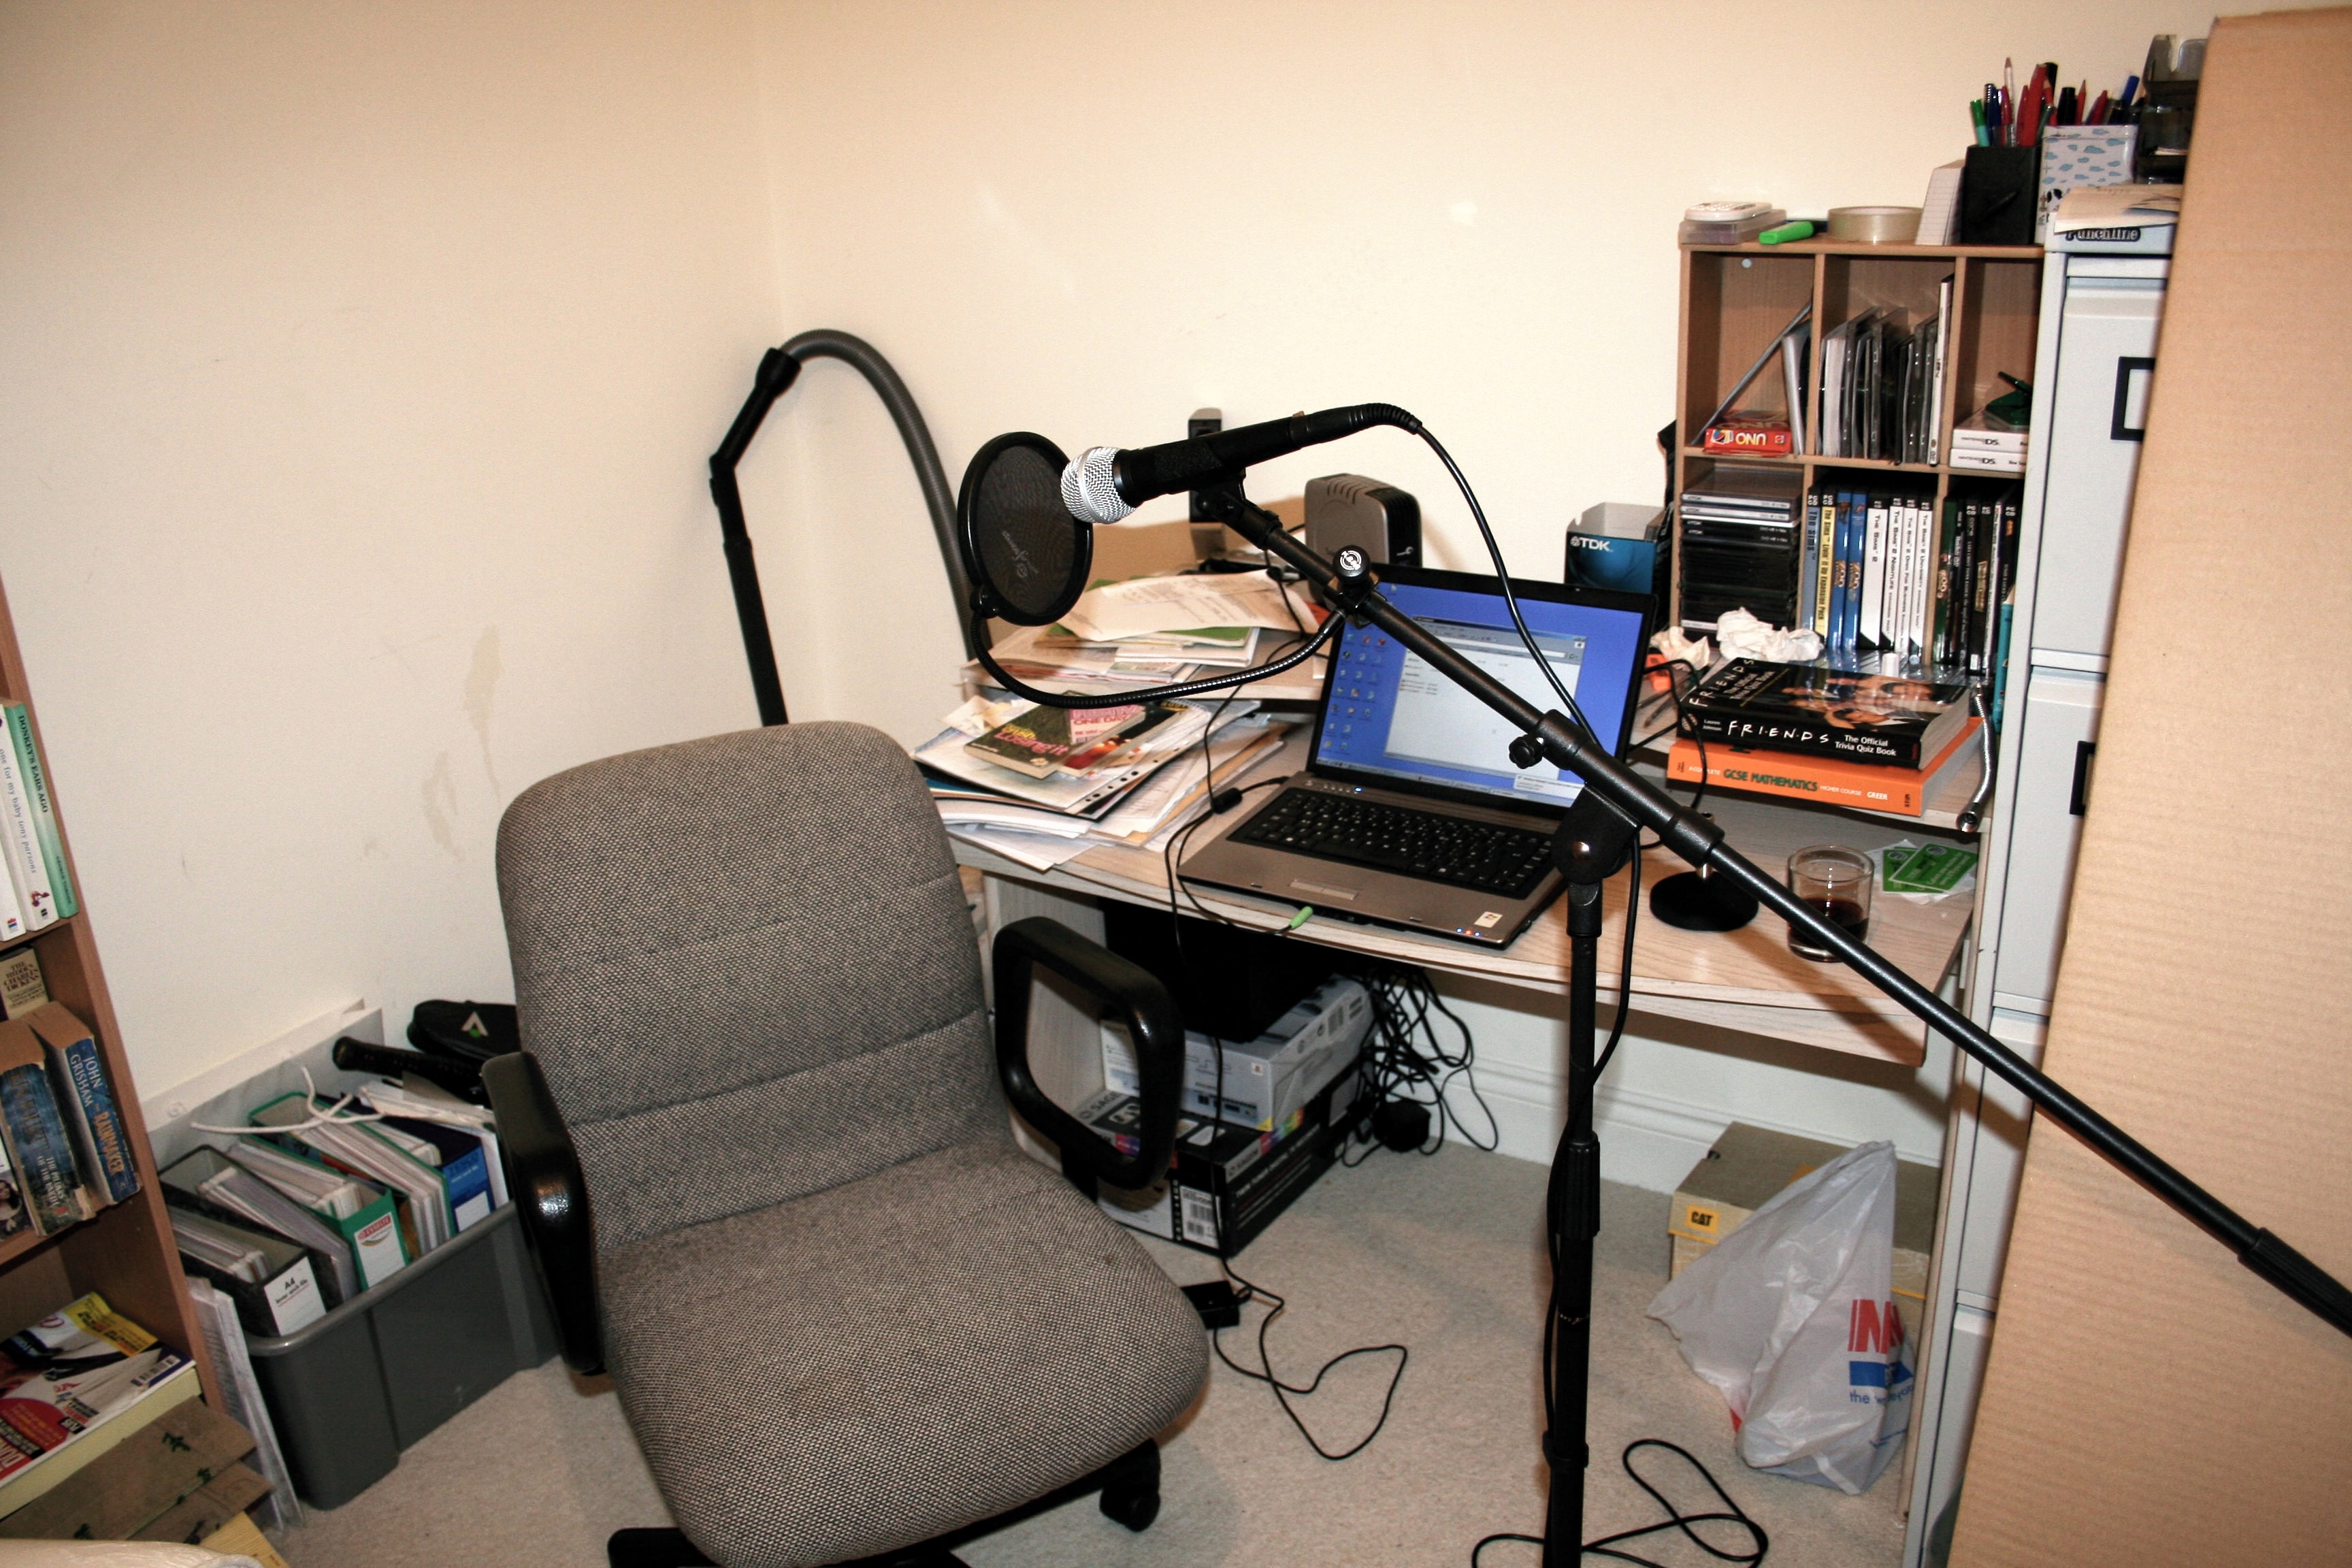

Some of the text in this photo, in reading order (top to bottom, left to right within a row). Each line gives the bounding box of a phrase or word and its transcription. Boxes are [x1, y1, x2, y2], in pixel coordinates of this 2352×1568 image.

[1735, 432, 1767, 446] UNO
[1808, 511, 1818, 526] The
[1824, 510, 1832, 519] The
[1578, 536, 1612, 552] TDK
[1819, 576, 1827, 605] Expansion
[994, 732, 1053, 754] Losing
[1049, 744, 1069, 755] it
[1835, 741, 1897, 756] Trivia Quiz Book
[1844, 734, 1888, 747] The Official
[18, 715, 48, 813] DONKEY'S EARS AGO
[7, 782, 16, 795] my
[1723, 768, 1748, 781] GCSE
[1751, 772, 1818, 791] MATHEMATICS
[1840, 787, 1863, 796] COURSE
[1867, 791, 1889, 800] GREER
[12, 797, 21, 817] baby
[18, 821, 27, 839] tony
[22, 841, 37, 874] parsons
[71, 1054, 94, 1107] GRISHAM
[83, 1056, 103, 1089] JOHN
[93, 1111, 125, 1177] RAINMAKER
[1692, 1211, 1712, 1226] CAT
[285, 1277, 295, 1289] A4
[1850, 1390, 1870, 1403] the
